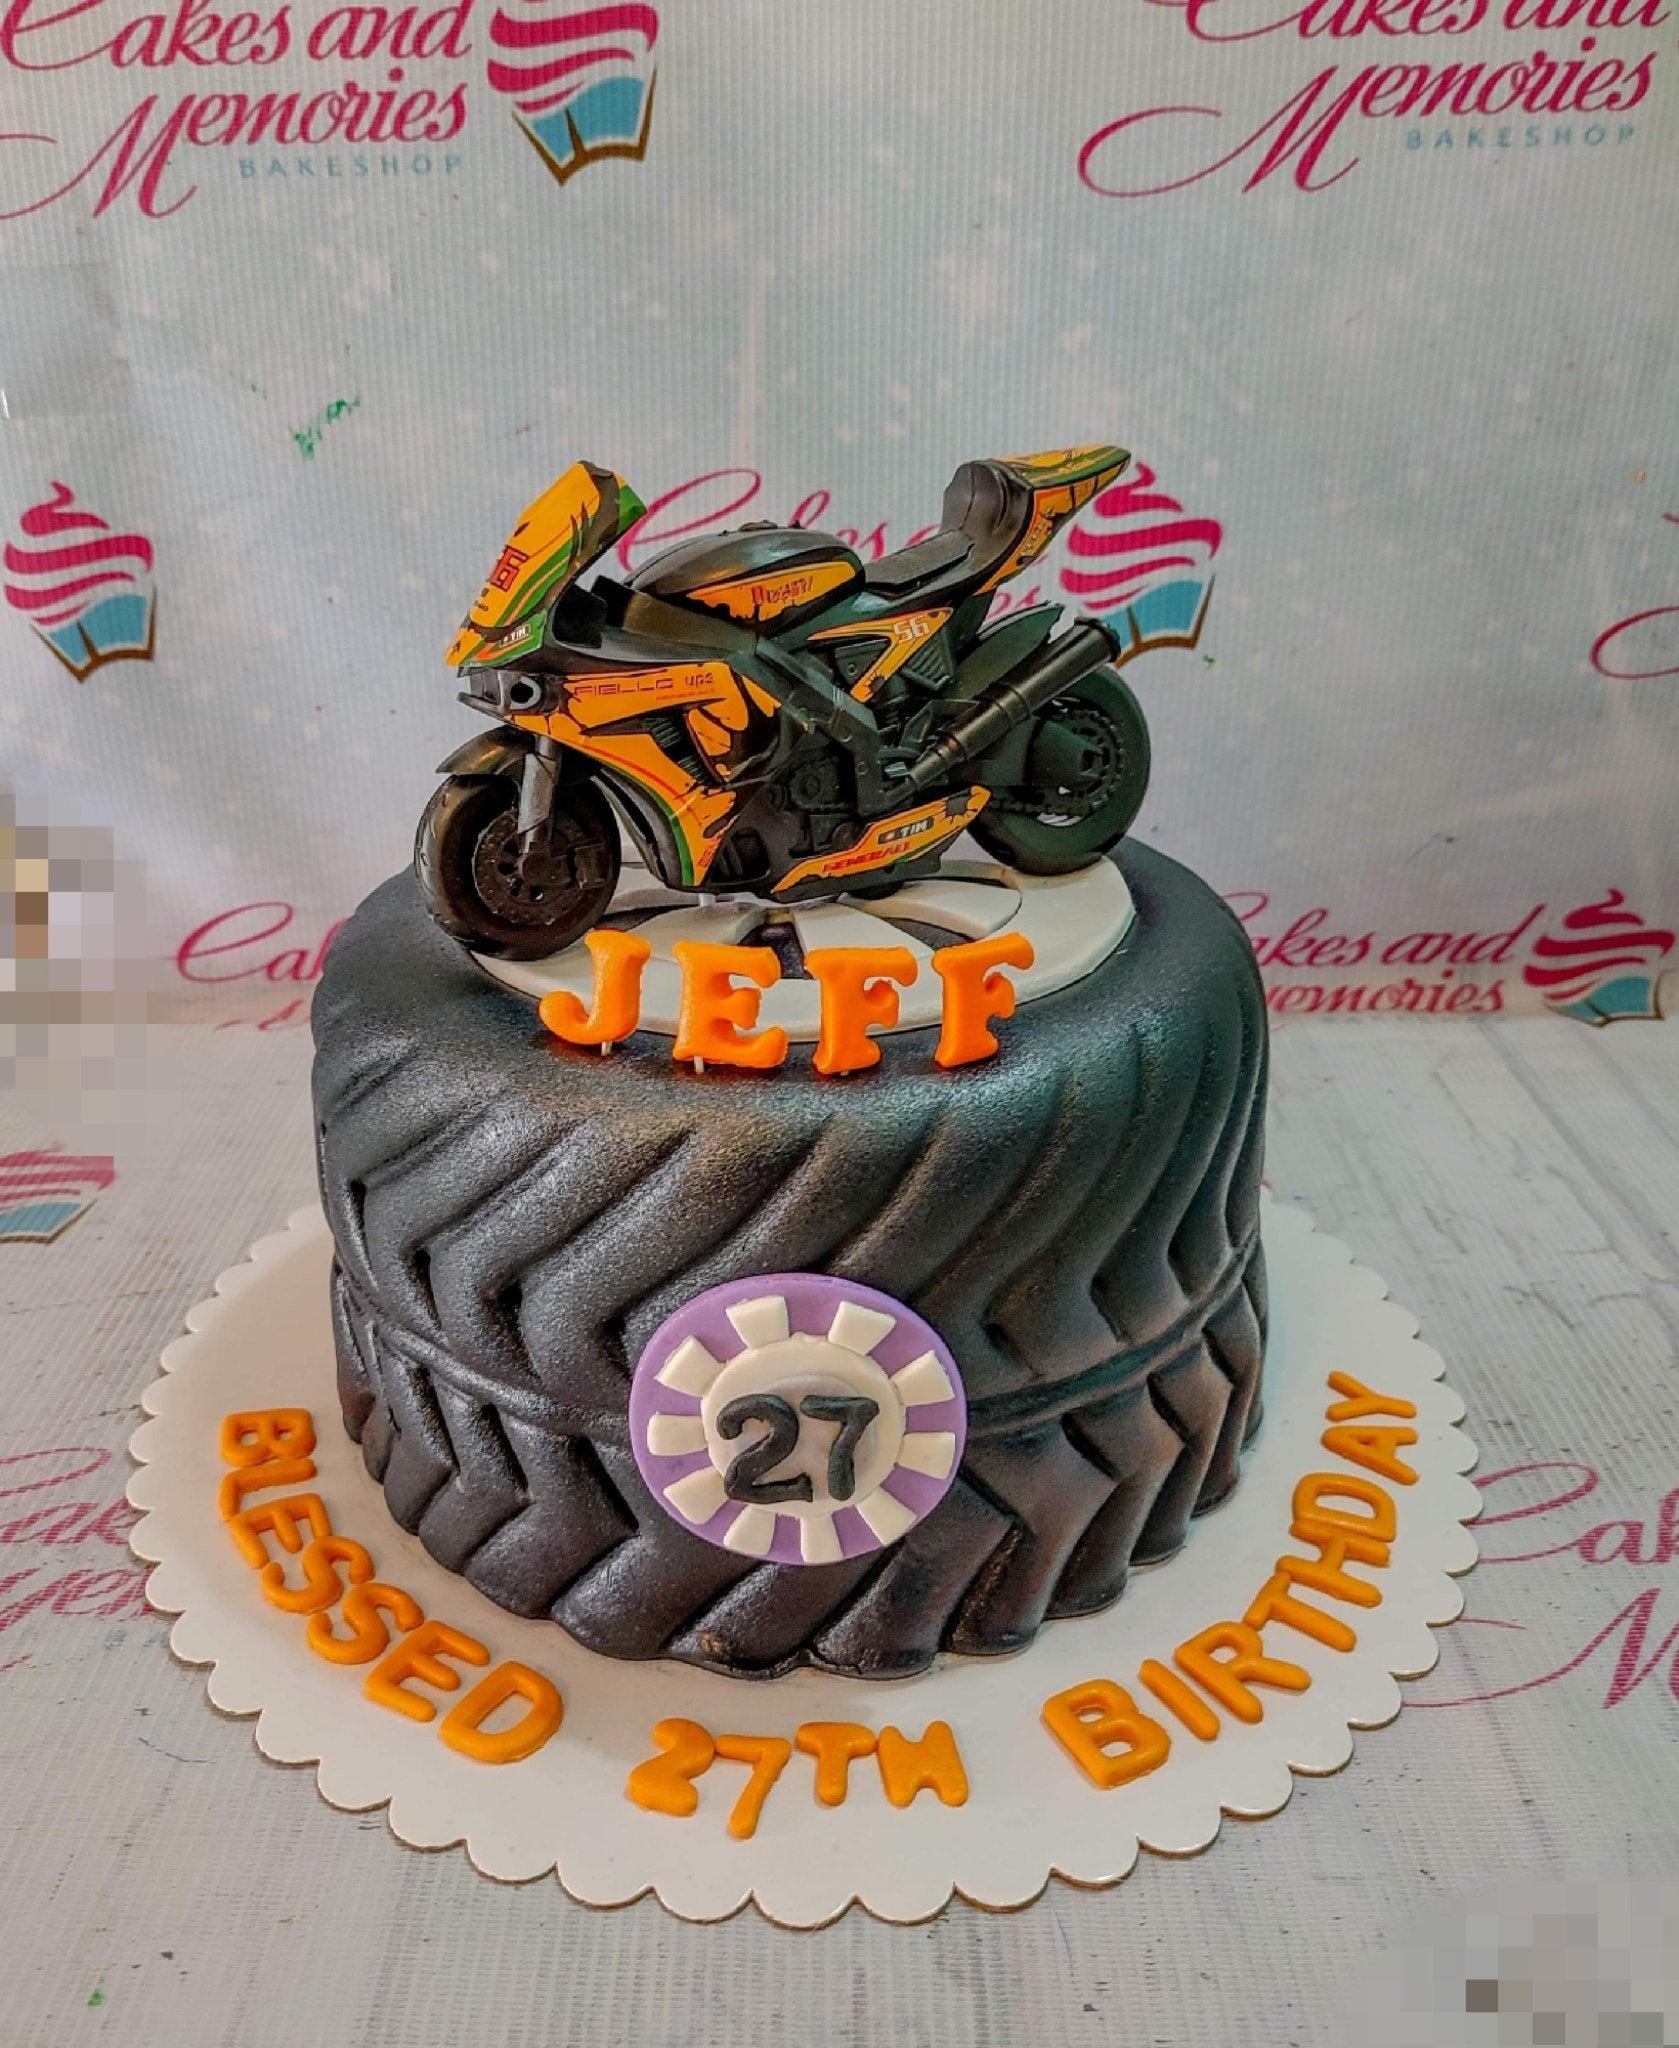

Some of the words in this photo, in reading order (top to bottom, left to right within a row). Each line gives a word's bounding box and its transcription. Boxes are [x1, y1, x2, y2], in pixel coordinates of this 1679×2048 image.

[307, 0, 474, 61] and
[0, 68, 468, 218] Memories
[1077, 37, 1658, 198] Memories
[1405, 124, 1637, 151] BAKESHOP
[239, 157, 463, 180] BAKESHOP
[900, 823, 929, 838] TIM
[1381, 903, 1547, 966] and
[538, 929, 1035, 1075] JEFF
[716, 1394, 880, 1504] 27
[218, 1408, 566, 1765] BLESSED
[624, 1717, 970, 1840] 27TH
[1040, 1370, 1419, 1790] BIRTHDAY
